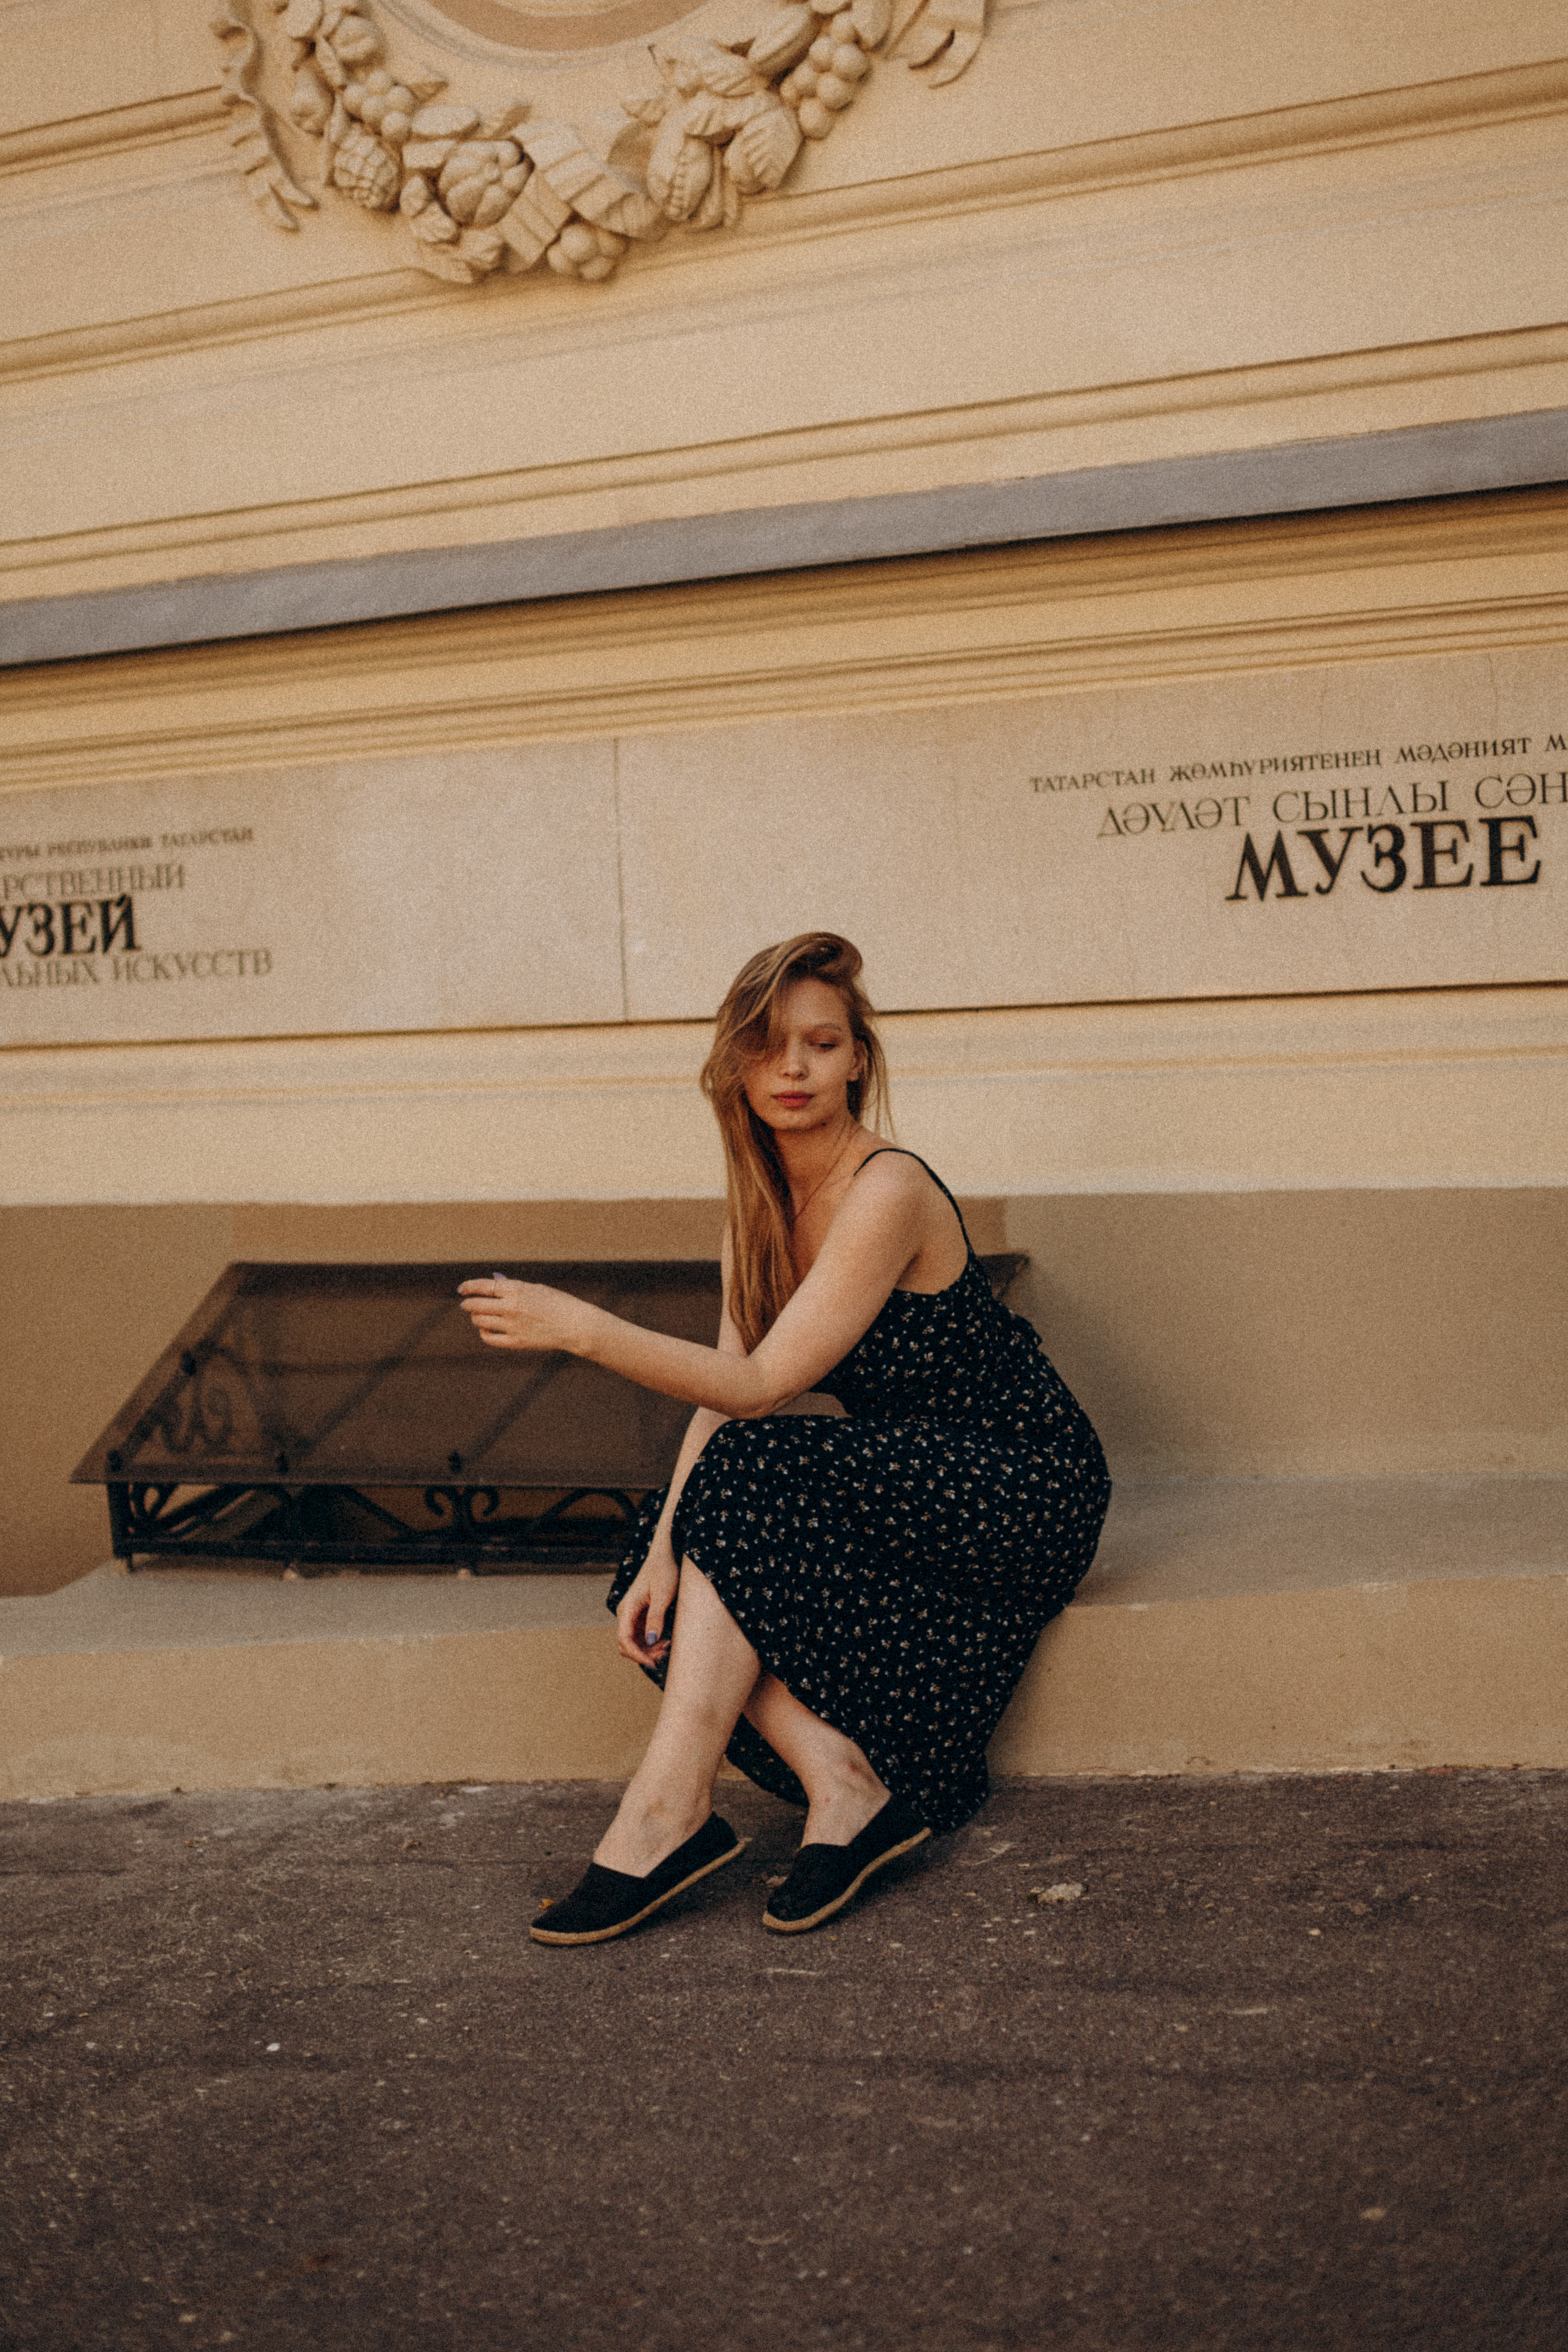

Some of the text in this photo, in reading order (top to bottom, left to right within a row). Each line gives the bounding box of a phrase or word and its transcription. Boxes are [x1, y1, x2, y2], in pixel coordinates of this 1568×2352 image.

[1030, 767, 1156, 793] ТАТАРСТАН
[1393, 737, 1531, 764] МӘДӘНИЯТ
[1273, 780, 1449, 823] СЫНЛЫ
[1475, 772, 1568, 809] СӘН
[1225, 815, 1541, 902] МУЗЕЕ
[0, 893, 141, 958] УЗЕЙ
[113, 947, 274, 984] ИСКУССТВ
